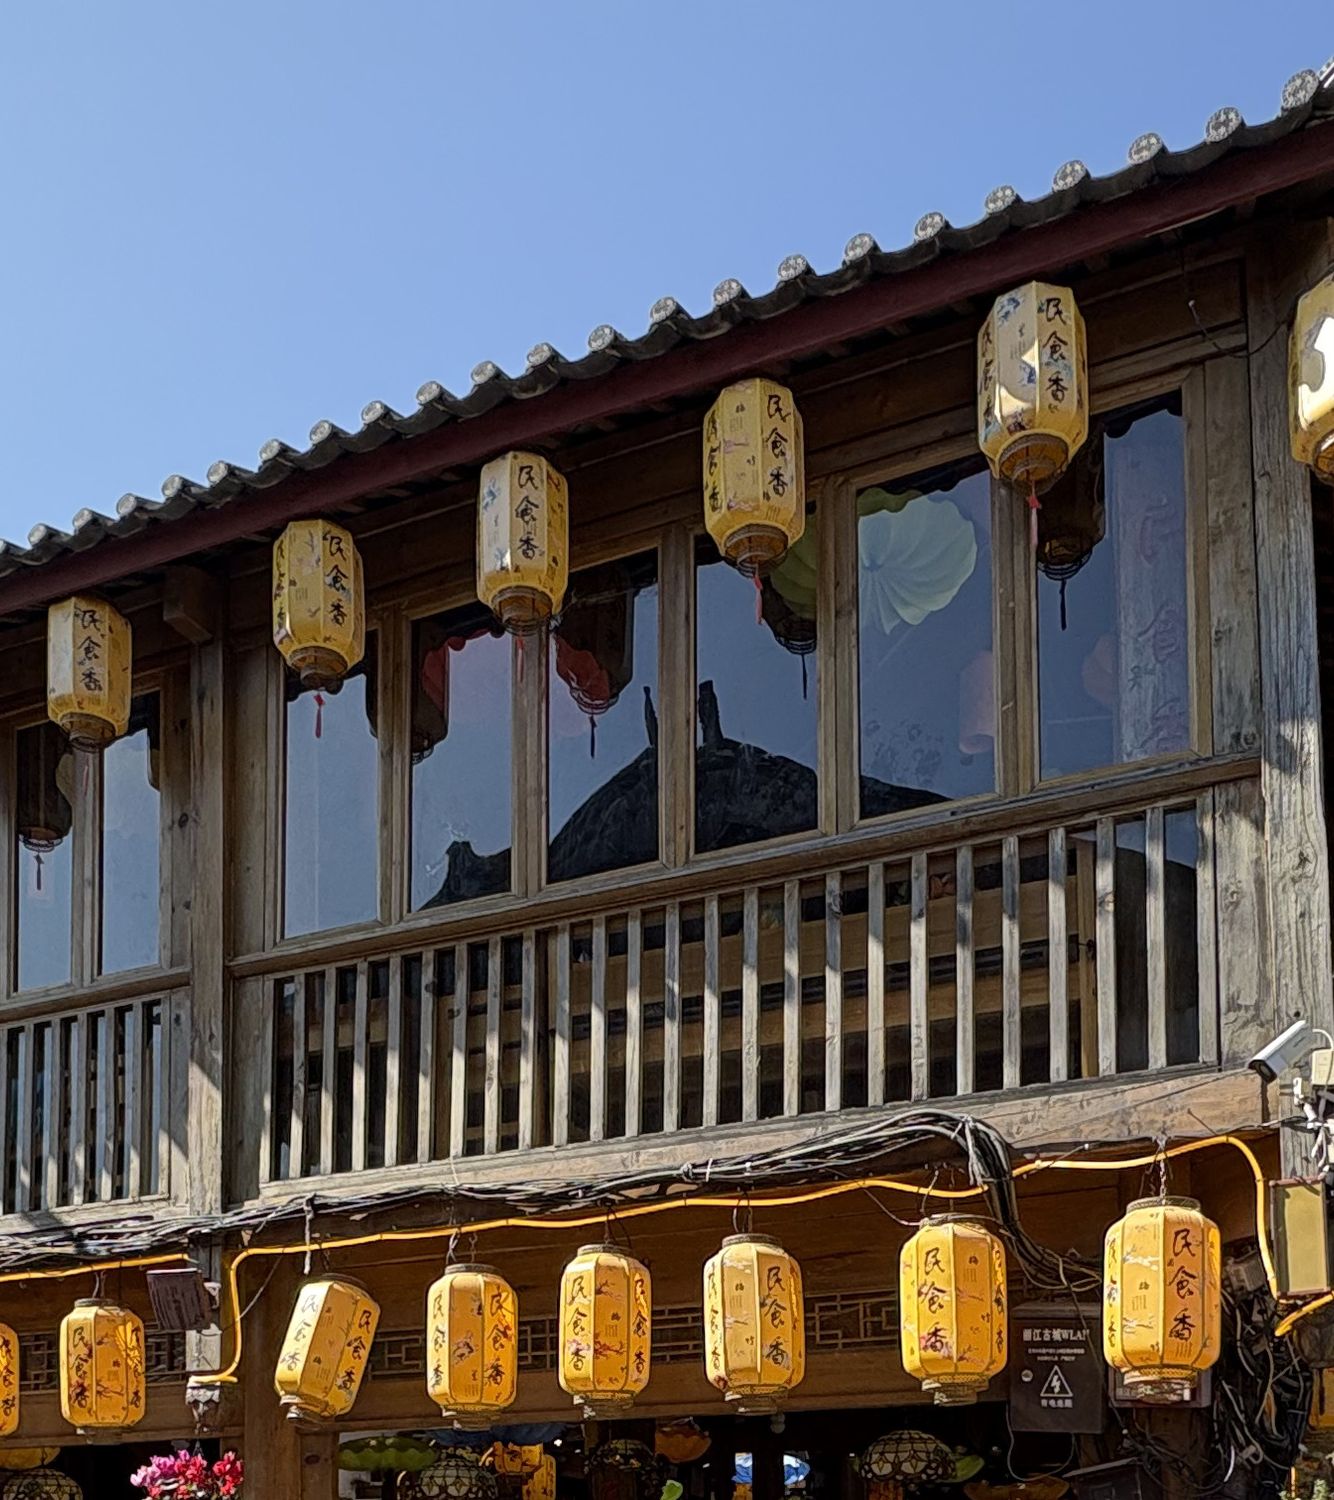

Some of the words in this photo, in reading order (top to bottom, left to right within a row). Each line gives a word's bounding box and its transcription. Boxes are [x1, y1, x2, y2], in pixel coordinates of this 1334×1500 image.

[568, 1275, 587, 1371] 民食香
[765, 1266, 787, 1366] 民食香
[921, 1247, 947, 1353] 民食香
[1169, 1228, 1197, 1342] 民食香
